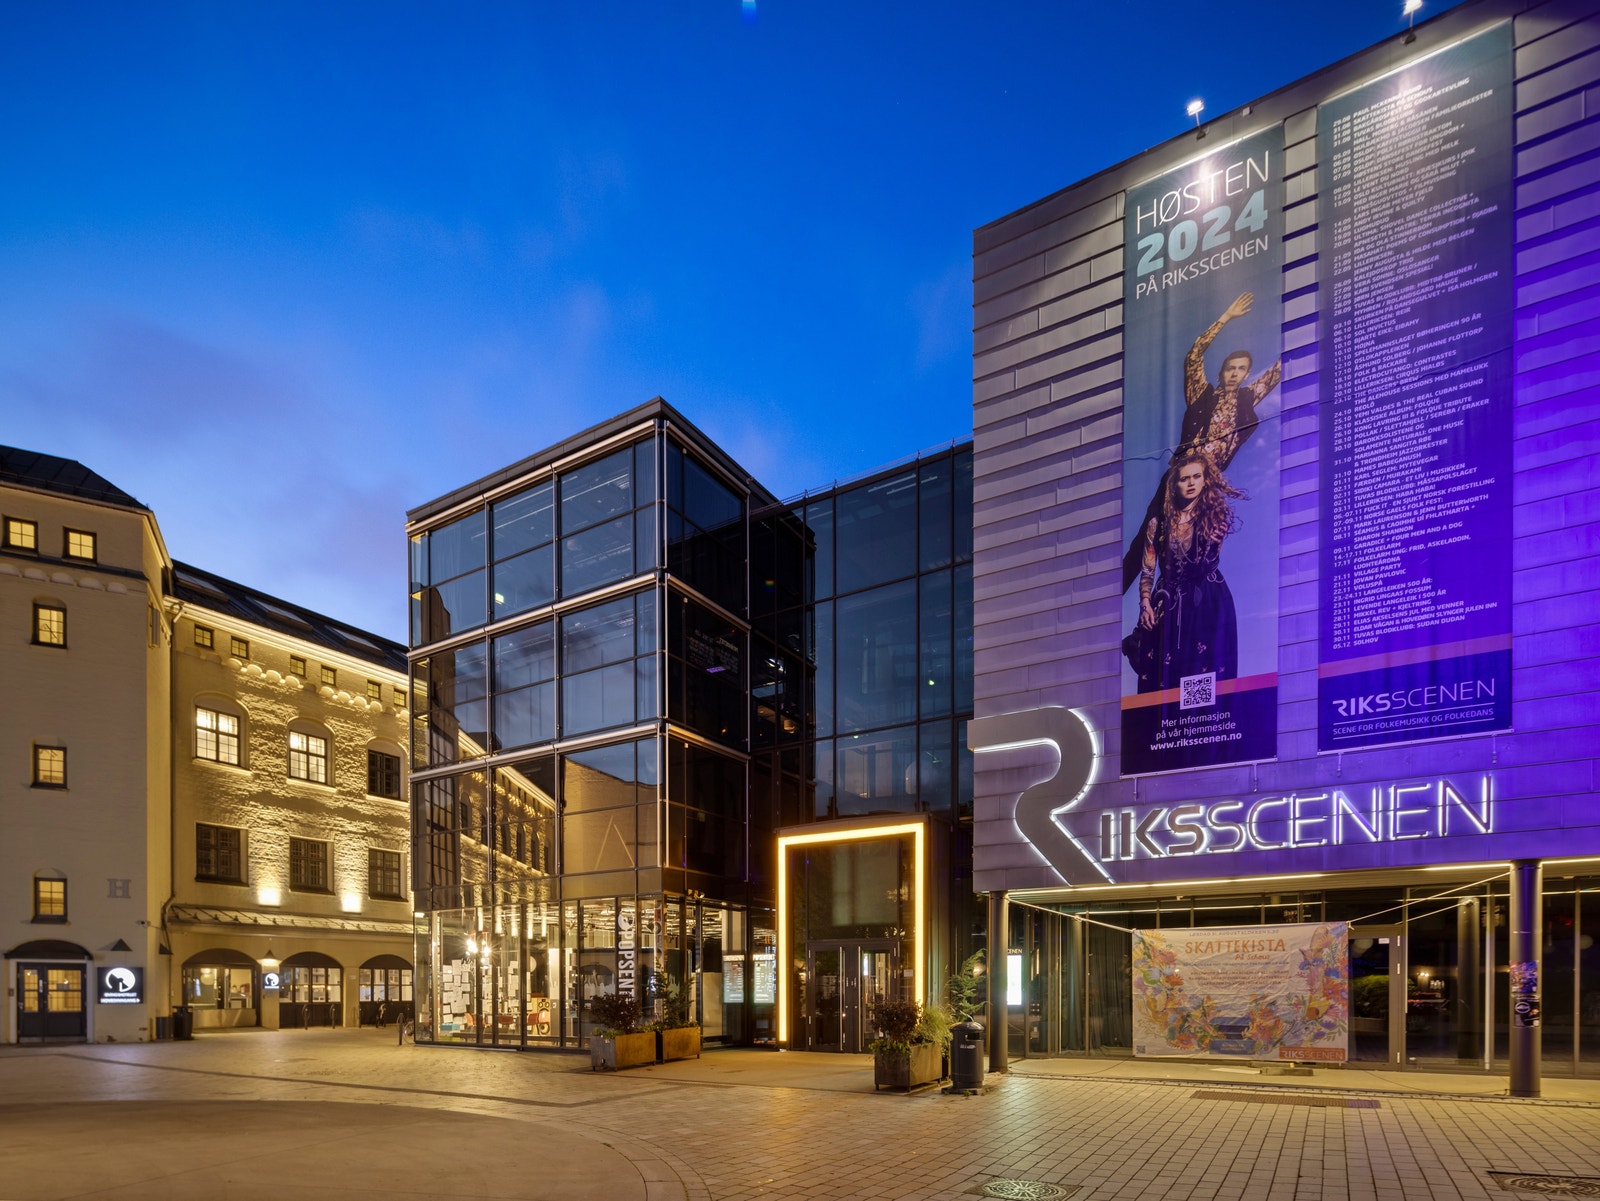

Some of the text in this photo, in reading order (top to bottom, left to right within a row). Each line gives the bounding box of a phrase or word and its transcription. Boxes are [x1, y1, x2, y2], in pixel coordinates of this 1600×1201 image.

[1137, 150, 1269, 234] HØSTEN
[1137, 189, 1268, 277] 2024
[1136, 235, 1268, 299] PÅ RIKSSCENEN
[1333, 320, 1350, 330] 03.10
[1354, 309, 1383, 323] SKURKEN
[1394, 290, 1440, 310] DANSEGULVET
[1460, 271, 1497, 289] HOLMGREN
[1333, 333, 1351, 344] 06.10
[1367, 318, 1395, 333] INVICTUS
[1334, 354, 1350, 364] 11.10
[1354, 334, 1413, 358] SPELEMANNSLAGET
[1334, 368, 1350, 378] 17.10
[1354, 358, 1380, 371] ÅSMUND
[1382, 349, 1410, 363] SOLBERG
[1416, 338, 1446, 353] JOHANNE
[1448, 327, 1482, 343] FLOTTORP
[1334, 342, 1408, 371] 12.10 OSLOKAPPLEIKEN
[1334, 349, 1456, 391] 19.10 ELECTROCUTANGO: CONTRASTES
[1334, 374, 1351, 385] 18.10
[1354, 368, 1369, 378] FOLK
[1378, 357, 1406, 371] RACKARE
[1334, 388, 1351, 398] 20.10
[1354, 375, 1393, 392] LILLERIKSEN:
[1396, 368, 1418, 380] CIRQUS
[1334, 416, 1351, 425] 25.10
[1354, 410, 1368, 419] YEMI
[1370, 403, 1394, 415] VALDES
[1417, 392, 1432, 402] REAL
[1434, 385, 1457, 397] CUBAN
[1459, 378, 1482, 390] SOUND
[1354, 439, 1390, 454] SOLAMENTE
[1392, 429, 1426, 444] NATURALI:
[1443, 419, 1463, 430] MUSIC
[1334, 455, 1438, 487] 01.11 KARL SEGLEM: MYTEVEGAR
[1333, 466, 1476, 507] 02.11 TUVAS BLODKLUBB: MÅSSAPOLSLAGET
[1333, 526, 1350, 534] 07.11
[1354, 520, 1371, 529] MARK
[1374, 511, 1411, 525] LAURENSON
[1420, 505, 1435, 515] JENN
[1437, 493, 1488, 510] BUTTERWORTH
[1333, 546, 1349, 555] 09.11
[1354, 538, 1384, 550] GARADICE
[1392, 532, 1408, 542] FOUR
[1333, 562, 1400, 582] 21.11 VILLAGE PARTY
[1333, 568, 1405, 589] 21.11 JOVAN PAVLOVIC
[1333, 579, 1382, 596] 22.11 VOLUSPÅ
[1333, 592, 1360, 602] 23.-24.11
[1364, 582, 1405, 596] LANGELEIKEN
[1333, 584, 1430, 609] 23.11 INGRID LINGAAS FOSSUM
[1333, 621, 1349, 630] 29.11
[1354, 617, 1370, 625] ELIAS
[1372, 610, 1407, 622] AKSELSENS
[1436, 600, 1463, 610] VENNER
[1333, 636, 1378, 650] 05.12 SOLHOV
[1332, 678, 1495, 717] RIKSSCENEN
[1156, 721, 1236, 740] på vår hjemmeside
[1162, 711, 1230, 727] Mer informasjon
[1333, 725, 1356, 735] SCENE
[1376, 716, 1429, 730] FOLKEMUSIKK
[1432, 714, 1442, 722] OG
[1444, 708, 1494, 721] FOLKEDANS
[1150, 732, 1242, 750] www.riksscenen.no
[967, 705, 1494, 885] RIKSSCENEN
[106, 879, 131, 899] H
[1185, 939, 1286, 954] SKATTEKISTA
[618, 931, 635, 1001] POPSENT
[1282, 1050, 1343, 1059] RIKSSCENEN
